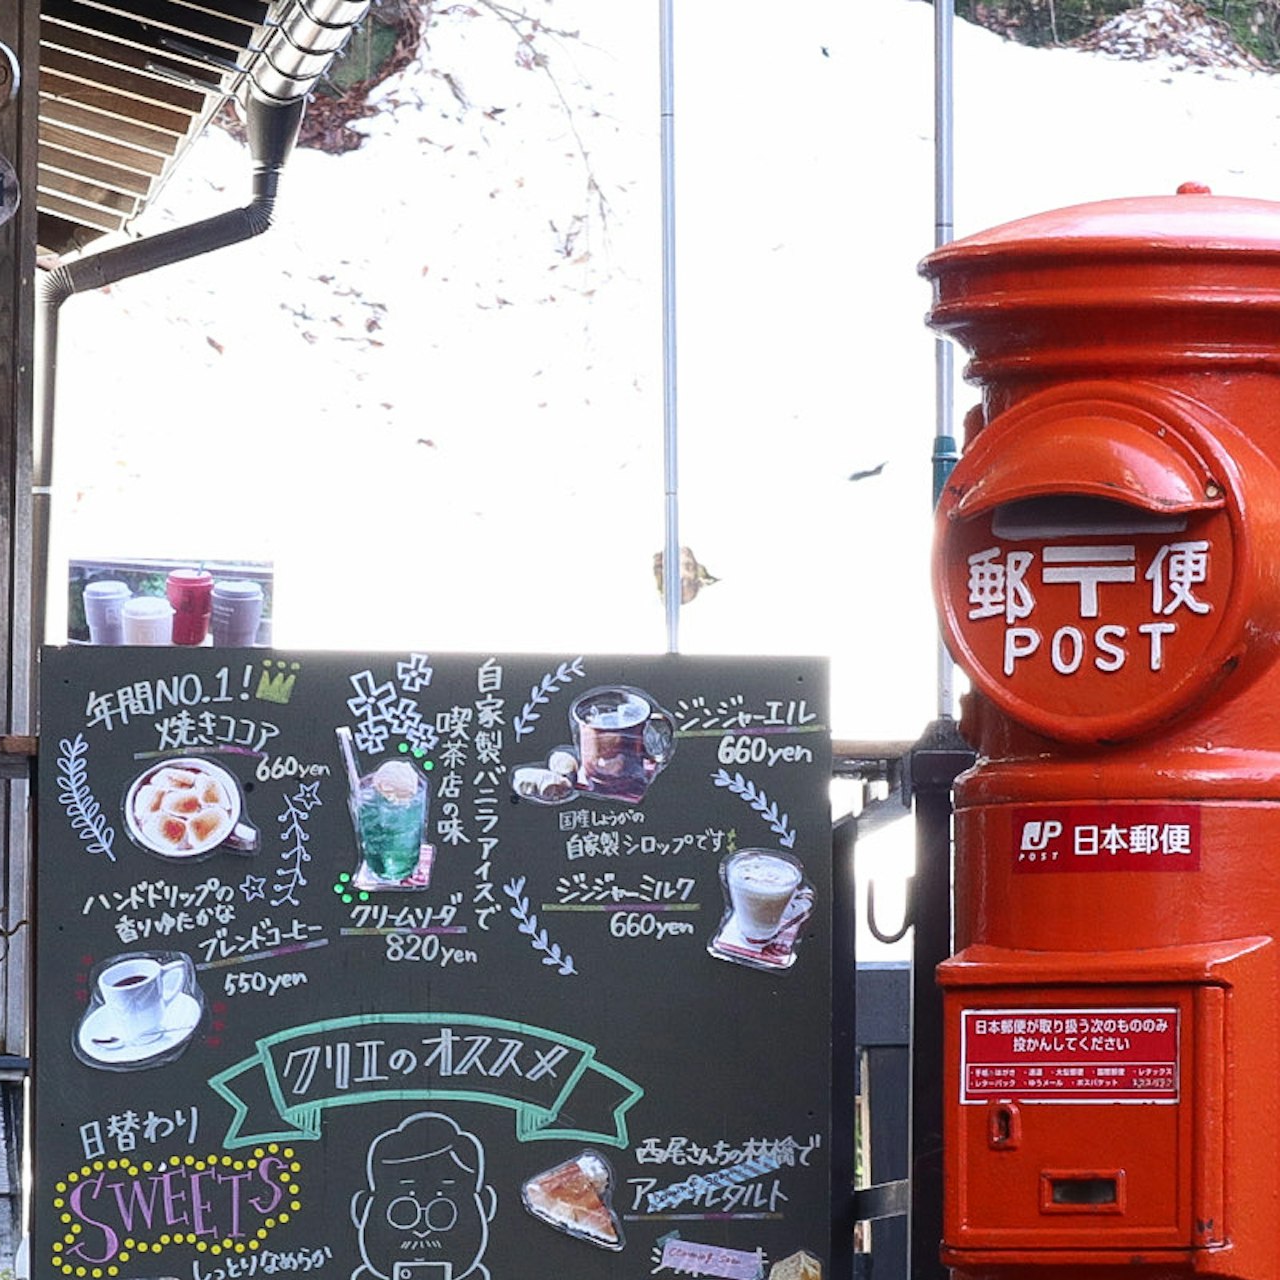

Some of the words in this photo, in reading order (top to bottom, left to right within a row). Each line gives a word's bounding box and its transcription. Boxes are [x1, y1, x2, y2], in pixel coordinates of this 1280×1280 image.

[1003, 621, 1177, 677] POST
[155, 709, 280, 752] 焼きココア
[717, 736, 813, 767] 660yen
[435, 705, 472, 846] 喫茶店の味
[472, 656, 507, 931] 自家製バニラアイスで
[558, 808, 645, 832] 国産しょうがの
[565, 826, 726, 861] 自家製シロップです
[1018, 851, 1059, 862] POST
[1074, 823, 1191, 855] 日本郵便
[82, 877, 235, 914] ハンドドリップの
[556, 871, 697, 904] ジンジャーミルク
[114, 903, 236, 943] 香りゆたかな
[350, 891, 464, 930] クリームソーダ
[609, 911, 694, 939] 660yen
[198, 918, 323, 963] ブレンドコーヒー
[386, 934, 478, 967] 820yen
[975, 1018, 1169, 1035] 日本郵便が取り扱う次のもののみ
[1013, 1036, 1131, 1052] 投かんしてください
[282, 1027, 570, 1095] クリエのオススメ
[79, 1106, 199, 1160] 日替わり
[65, 1156, 289, 1264] SWEETS
